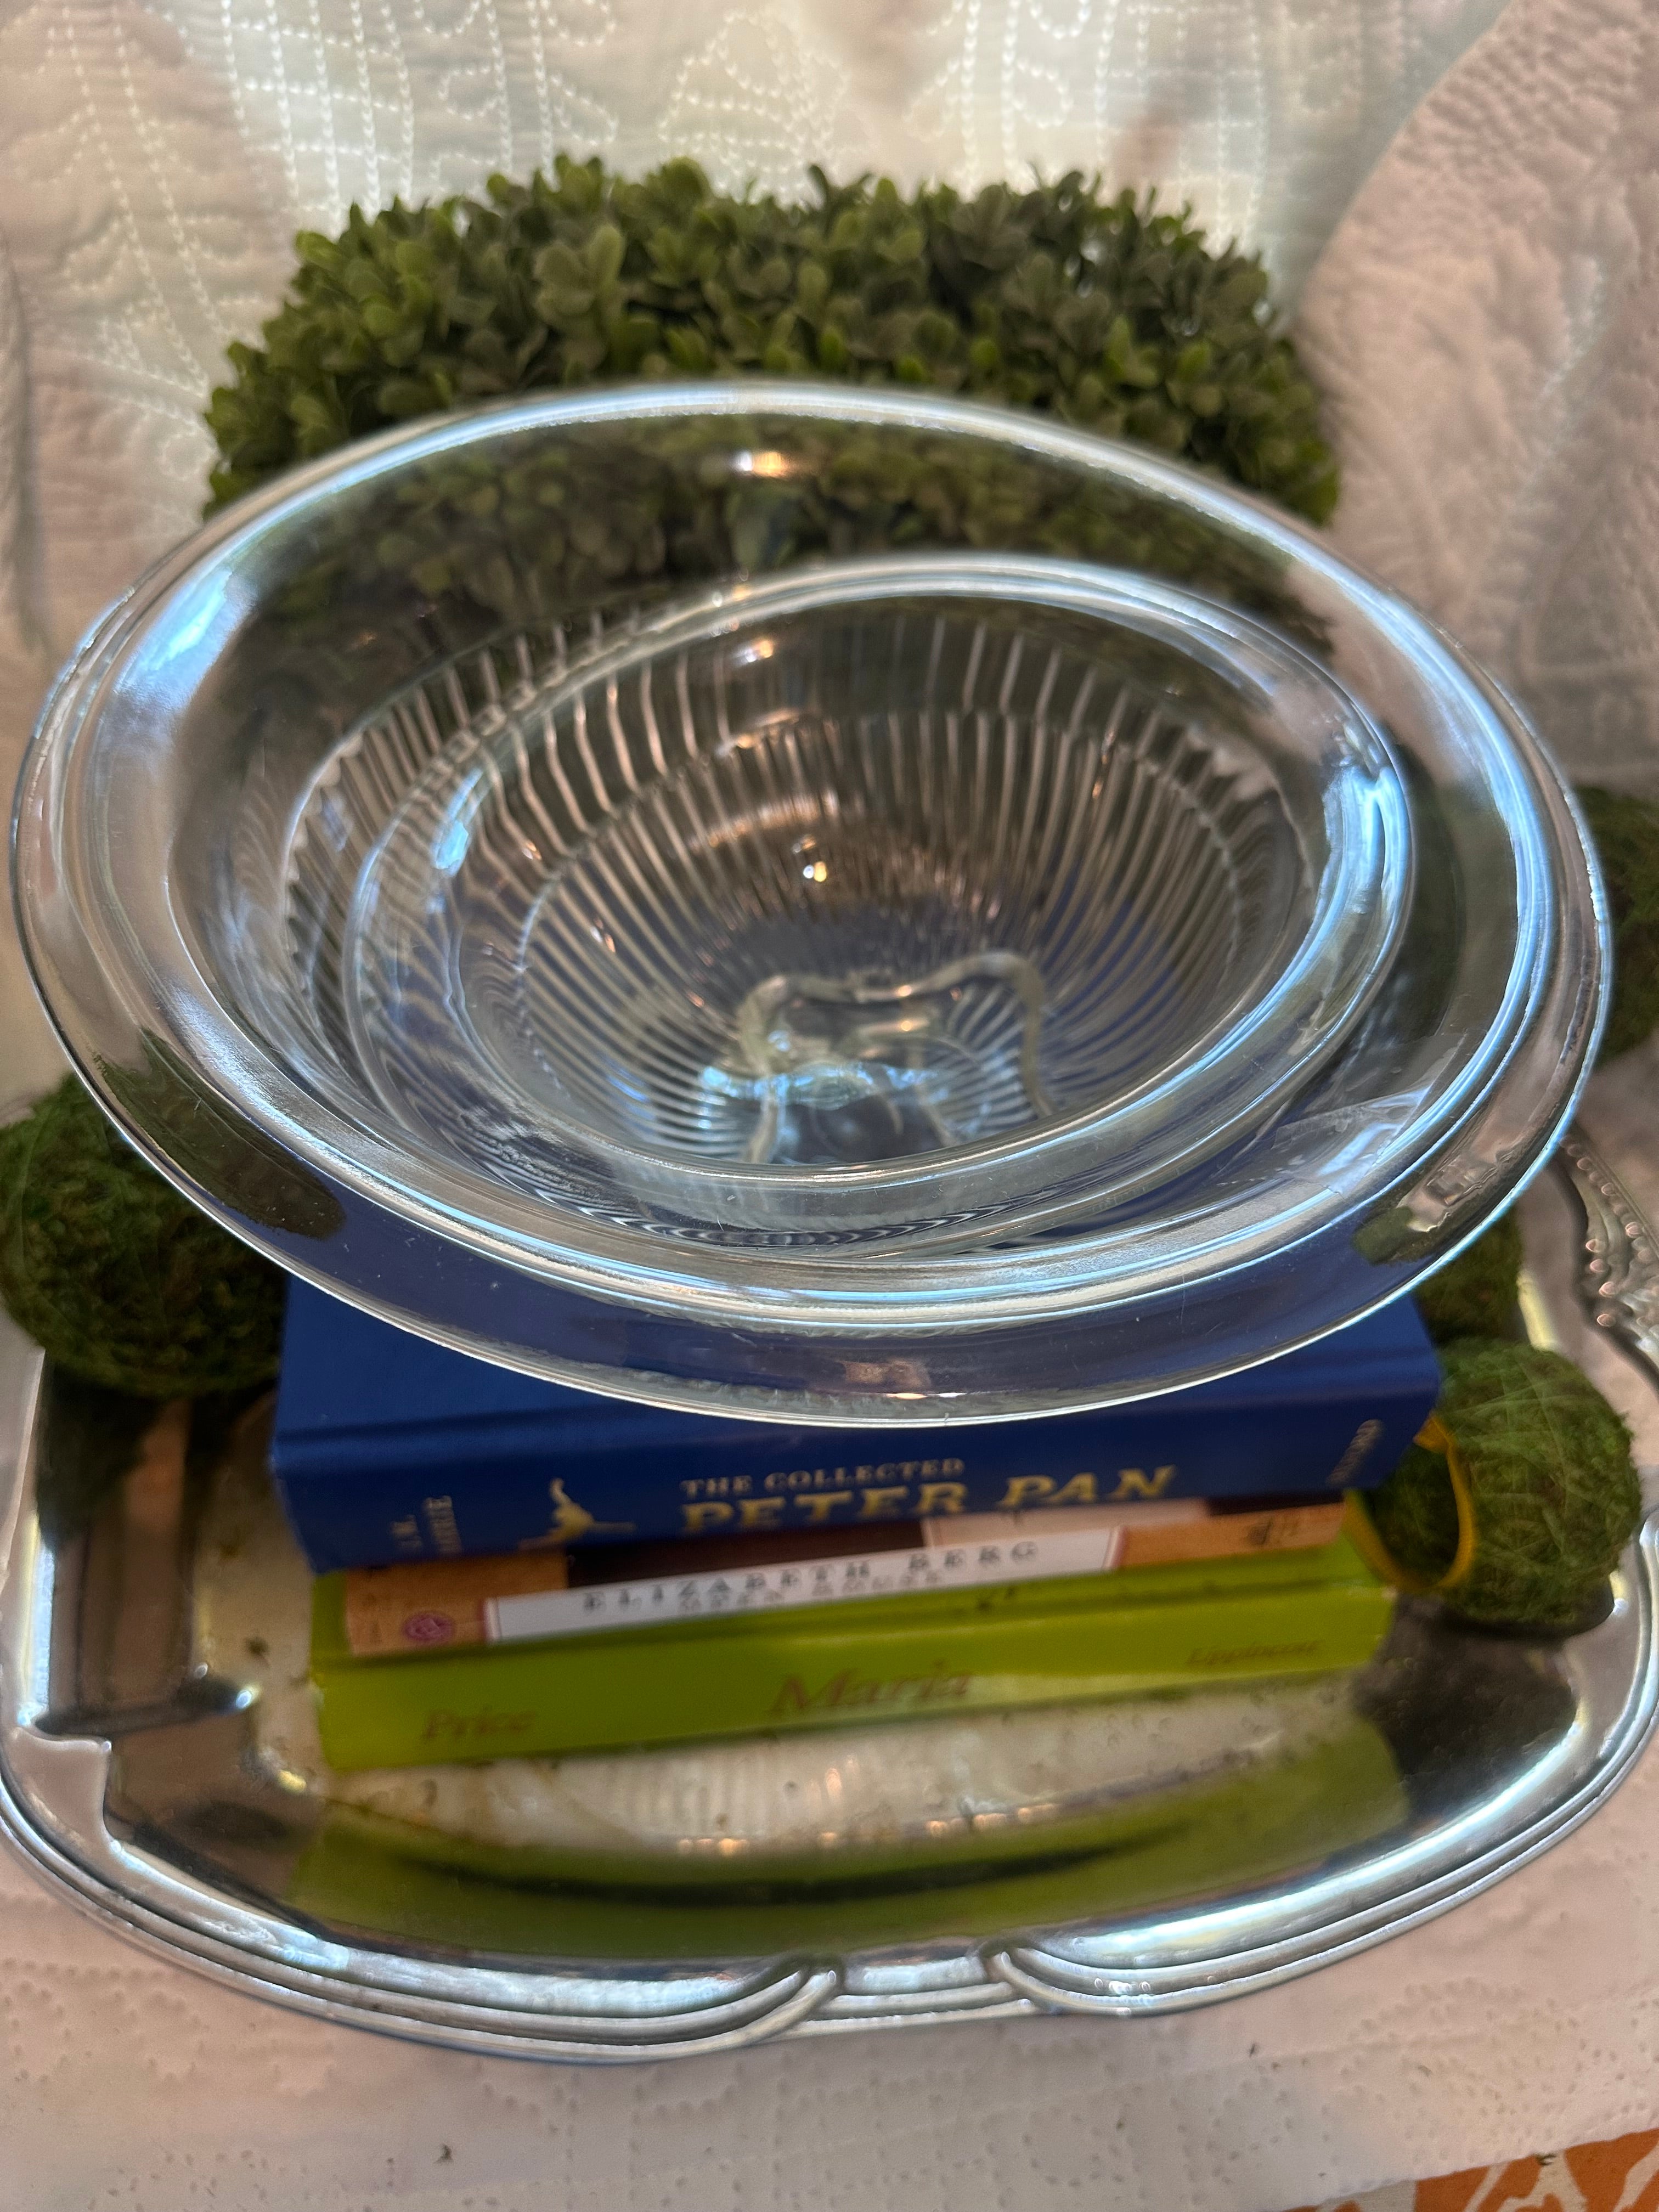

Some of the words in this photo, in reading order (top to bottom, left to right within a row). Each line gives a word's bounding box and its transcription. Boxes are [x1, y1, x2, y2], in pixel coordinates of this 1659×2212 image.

[680, 1475, 752, 1497] THE
[764, 1458, 964, 1491] COLLECTED
[680, 1482, 968, 1533] PETER
[997, 1464, 1176, 1510] PAN
[582, 1561, 871, 1613] ELIZABETH
[909, 1541, 1038, 1571] BERG
[769, 1657, 972, 1716] Maria
